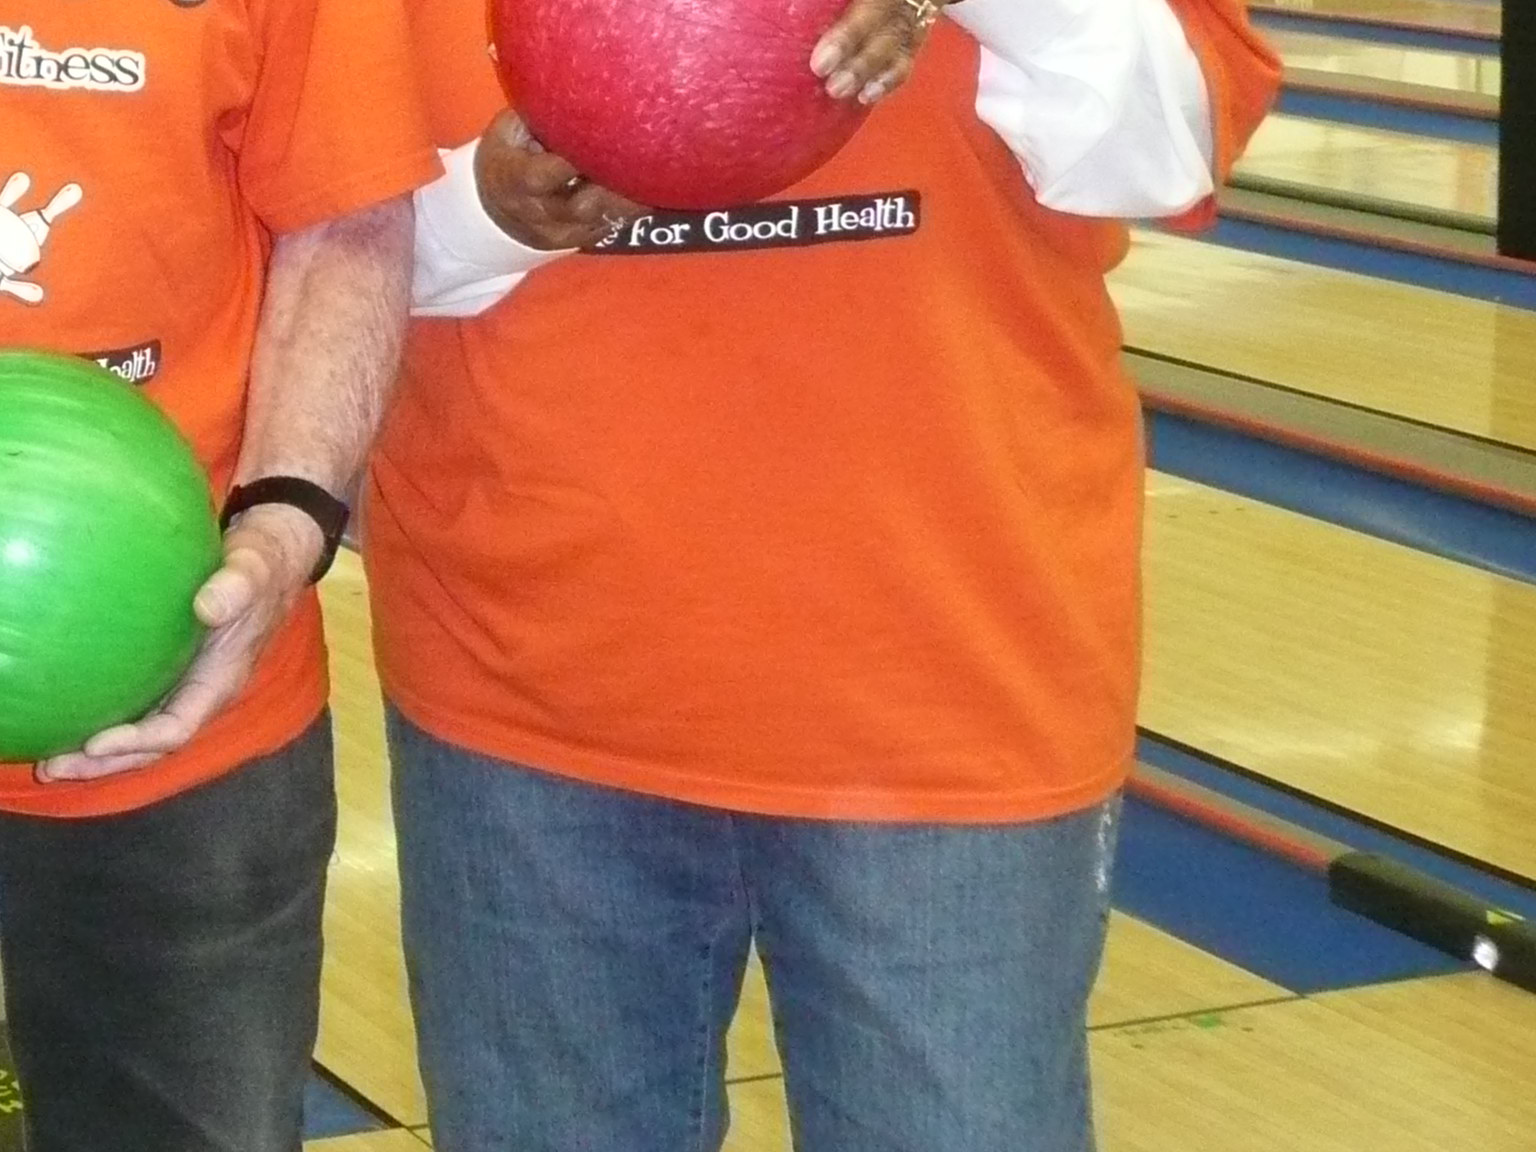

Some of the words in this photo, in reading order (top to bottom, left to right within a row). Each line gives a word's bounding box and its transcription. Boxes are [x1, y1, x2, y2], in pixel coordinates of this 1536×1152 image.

[629, 216, 690, 246] For
[703, 206, 797, 242] Good
[815, 198, 914, 234] Health
